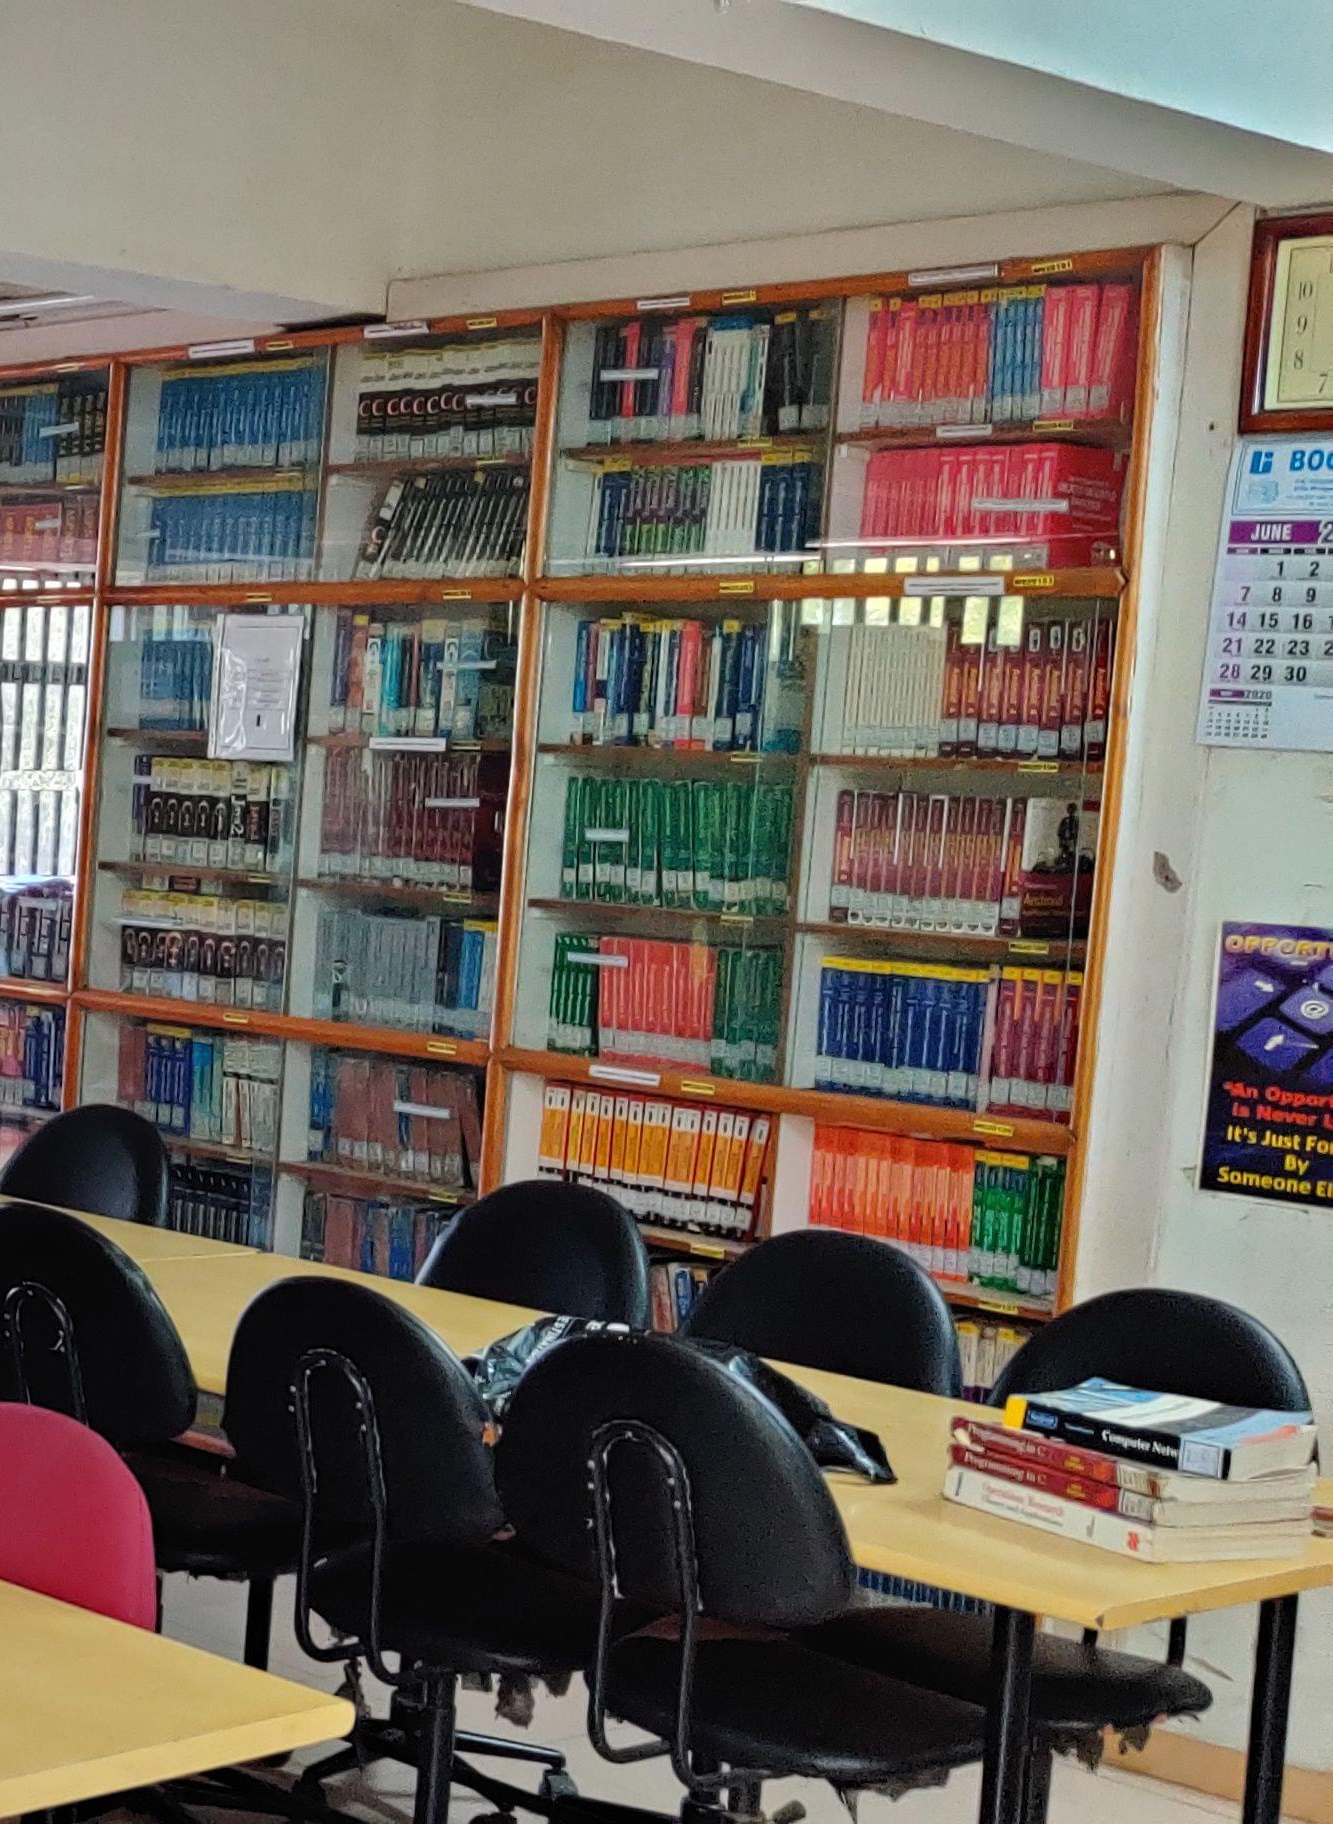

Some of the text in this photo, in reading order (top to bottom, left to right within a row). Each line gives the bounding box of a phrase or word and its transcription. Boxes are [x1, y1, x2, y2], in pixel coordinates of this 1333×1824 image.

[1299, 280, 1313, 300] 10
[1296, 315, 1308, 334] 9
[1293, 350, 1304, 370] 8
[1318, 373, 1328, 394] 7
[1250, 523, 1292, 541] JUNE
[1276, 561, 1320, 577] 1 2
[1241, 586, 1316, 603] 7 8 9
[1227, 611, 1313, 630] 14 15 16
[1222, 637, 1242, 654] 21
[1254, 638, 1275, 655] 22
[1287, 640, 1310, 656] 23
[1219, 663, 1307, 682] 28 29 30
[1225, 935, 1333, 958] OPPORT
[1256, 1104, 1317, 1126] Never
[1227, 1125, 1257, 1144] It's
[1261, 1130, 1300, 1151] Just
[1284, 1153, 1310, 1176] By
[1216, 1165, 1312, 1195] Someone
[1101, 1429, 1151, 1452] Computer
[964, 1450, 1025, 1481] Programming
